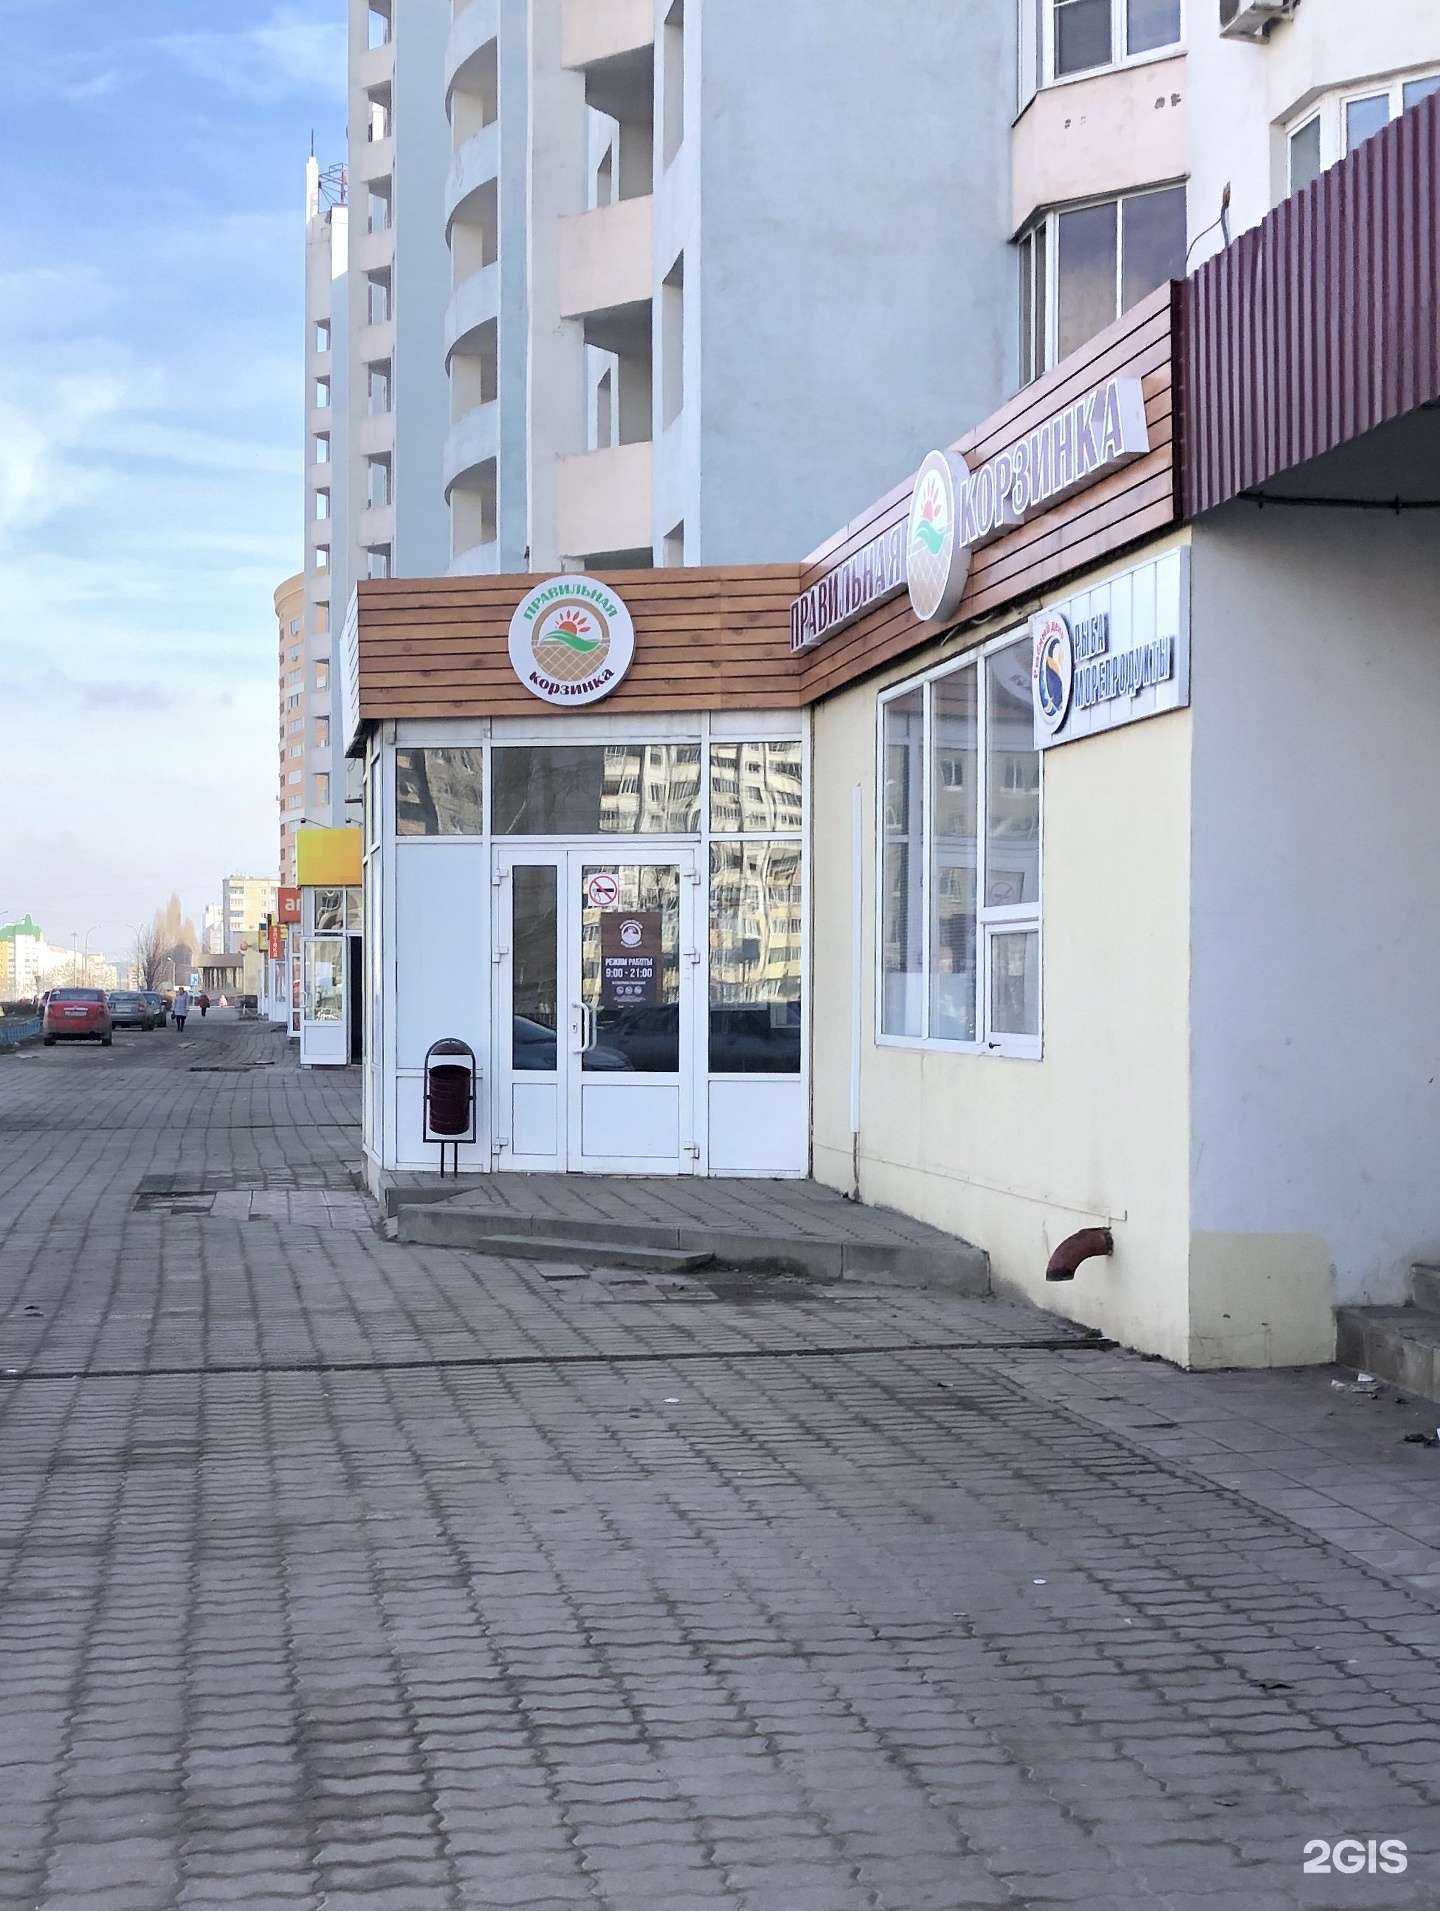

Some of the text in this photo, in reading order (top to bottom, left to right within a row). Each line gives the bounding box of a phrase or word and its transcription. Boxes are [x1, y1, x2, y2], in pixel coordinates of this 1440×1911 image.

[790, 377, 1125, 653] ПРАВИЛЬНАЯ КОРЗИНКА
[523, 583, 618, 621] ПРАВИЛЬНАЯ
[1074, 613, 1107, 662] РЫБА
[529, 668, 615, 695] корзинка
[1074, 635, 1170, 709] МОРЕПРОДУКТЫ
[605, 968, 623, 978] 9:00
[630, 968, 653, 978] 21:00
[629, 957, 653, 966] РАБОТЫ
